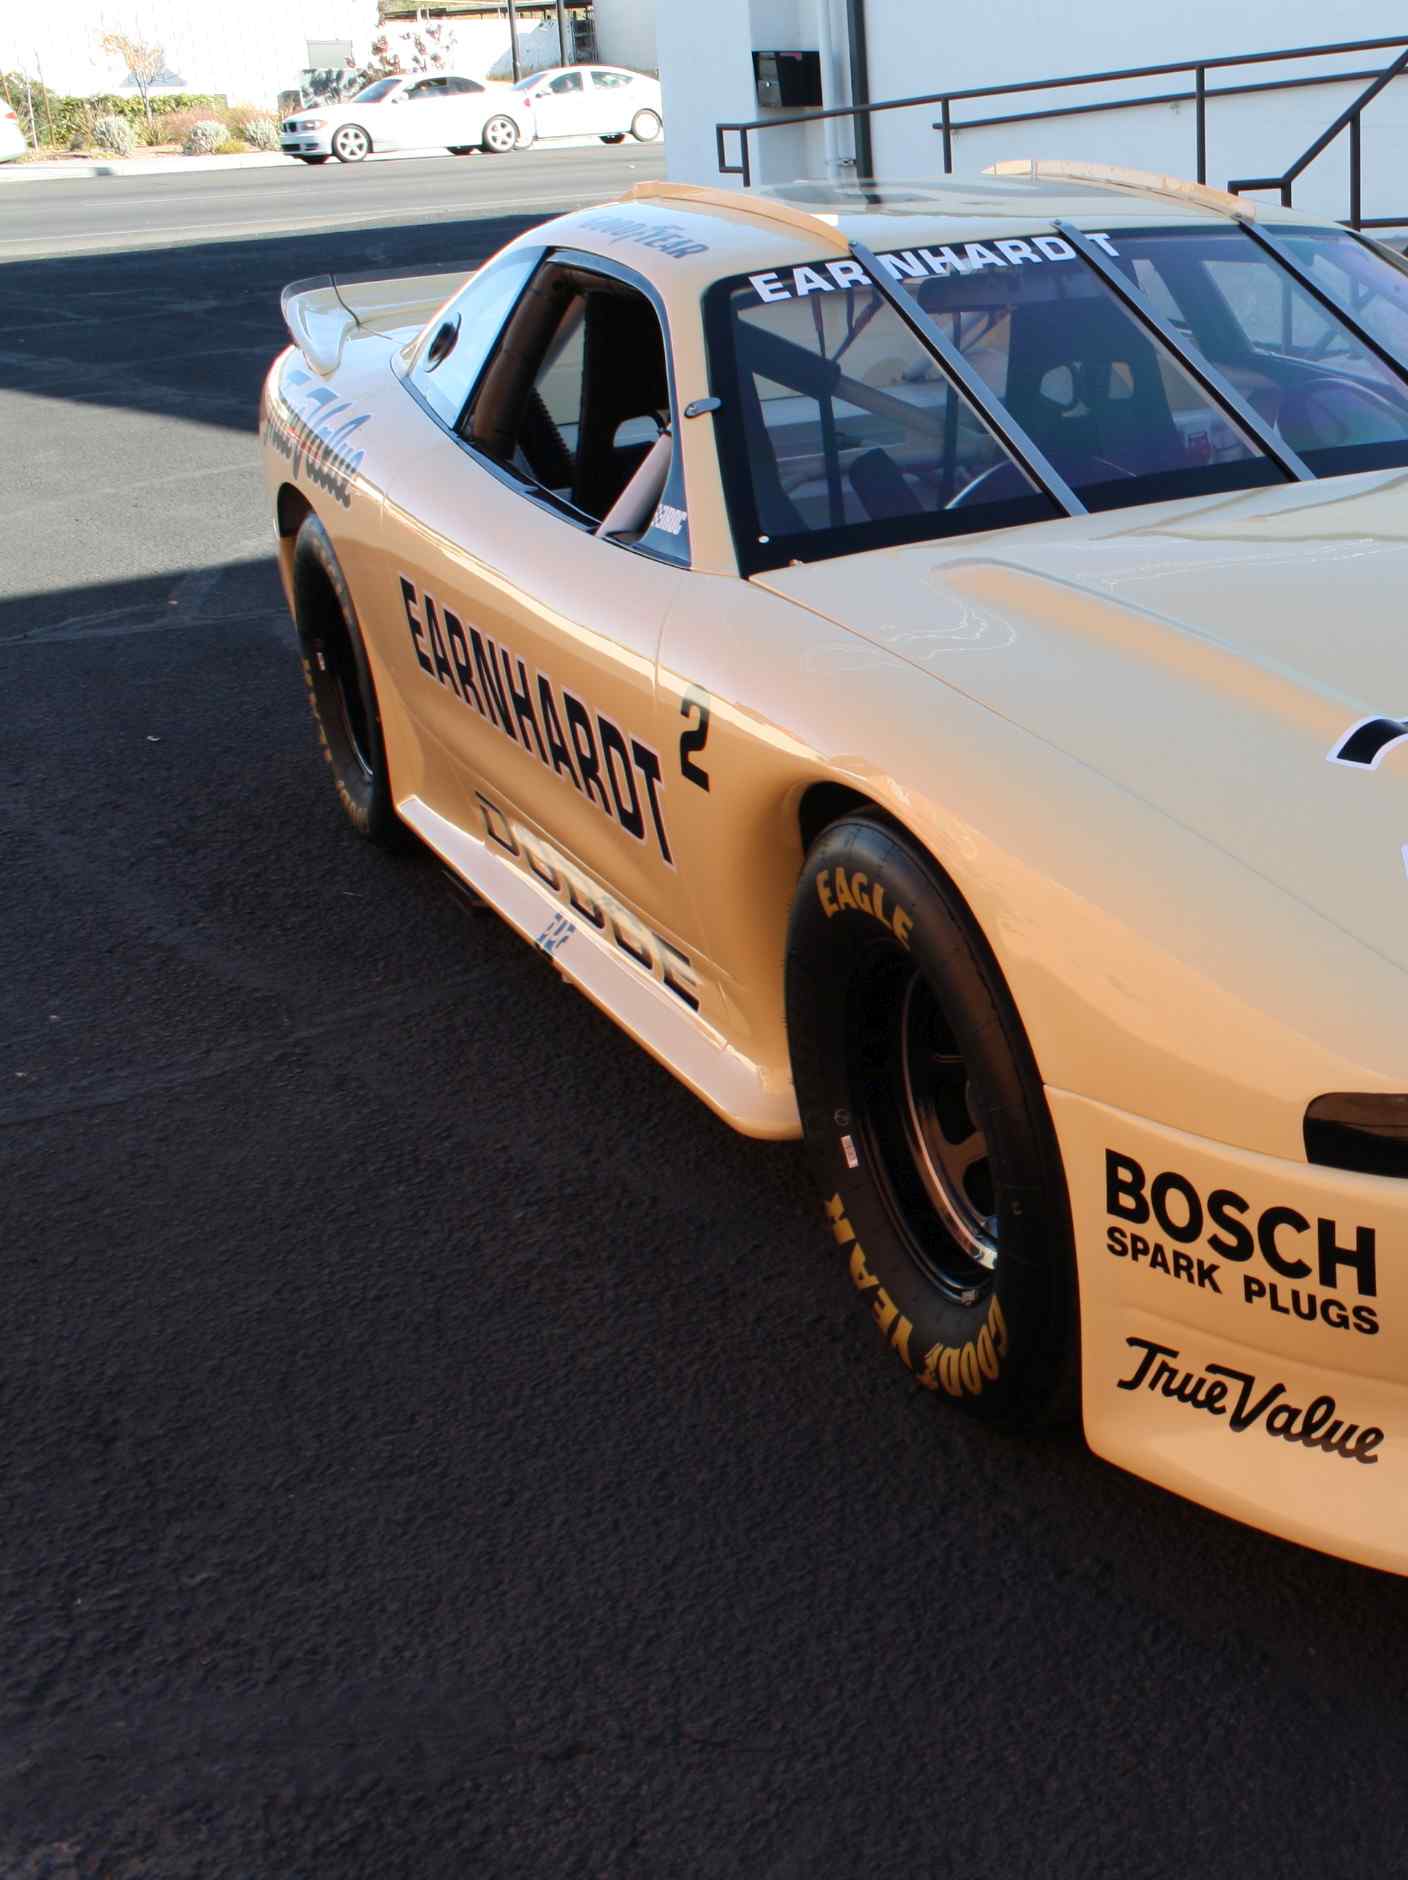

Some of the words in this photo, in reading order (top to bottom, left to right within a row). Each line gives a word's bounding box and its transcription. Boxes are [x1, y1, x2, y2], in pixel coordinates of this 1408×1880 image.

[748, 232, 1121, 302] EARNHARDT
[400, 574, 674, 866] EARNHARDT
[680, 684, 710, 791] 2
[815, 866, 913, 952] EAGLE
[1105, 1148, 1377, 1297] BOSCH
[1106, 1225, 1221, 1293] SPARK
[1243, 1275, 1380, 1336] PLUGS
